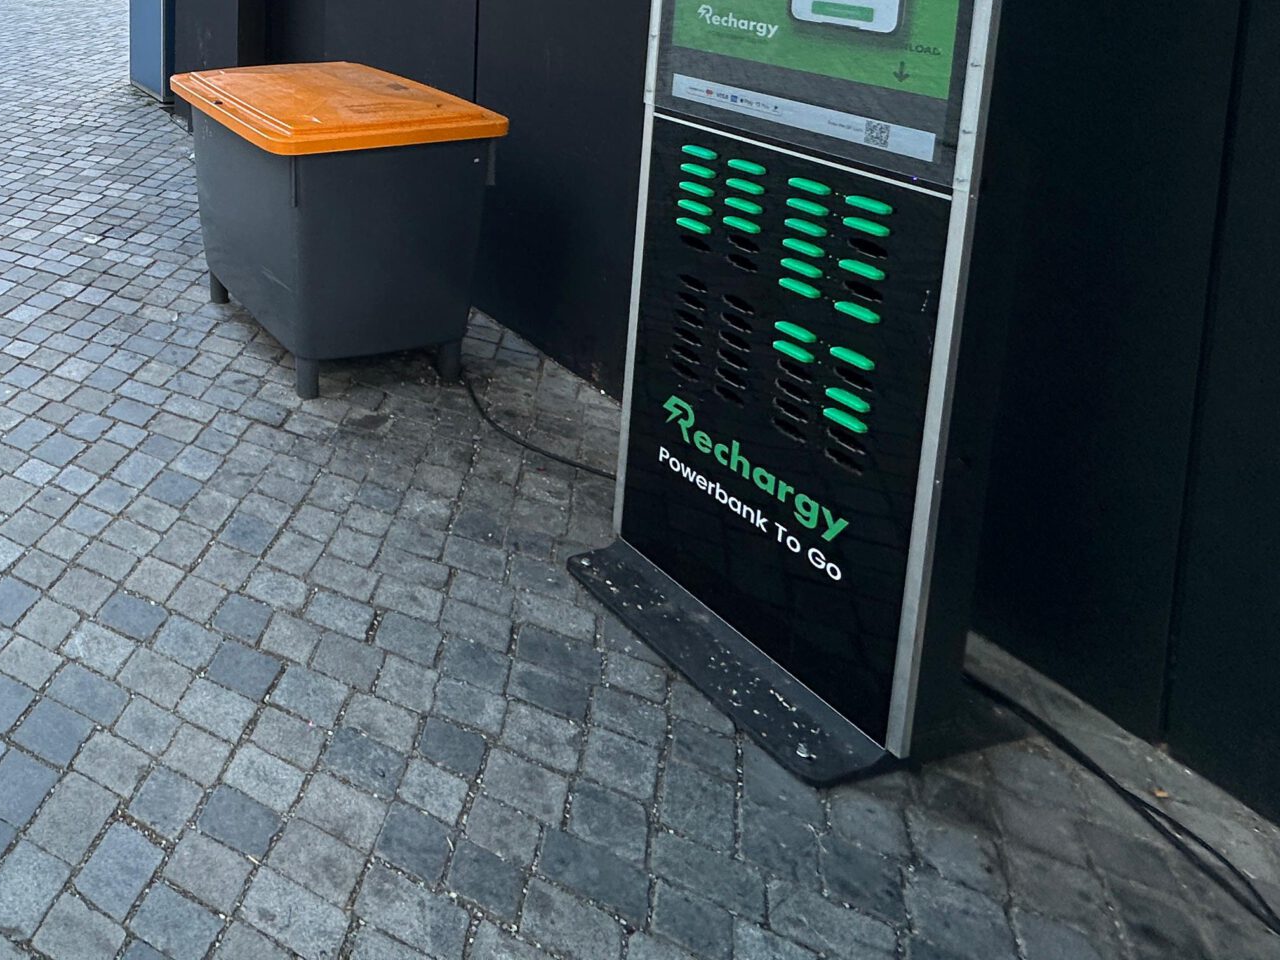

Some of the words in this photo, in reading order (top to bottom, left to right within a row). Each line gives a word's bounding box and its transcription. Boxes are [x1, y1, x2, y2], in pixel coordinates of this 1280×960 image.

[697, 4, 779, 38] Rechargy
[715, 91, 730, 100] VISA
[663, 395, 849, 541] Rechargy
[658, 446, 768, 533] Powerbank
[774, 522, 801, 553] To
[807, 547, 842, 581] Go
